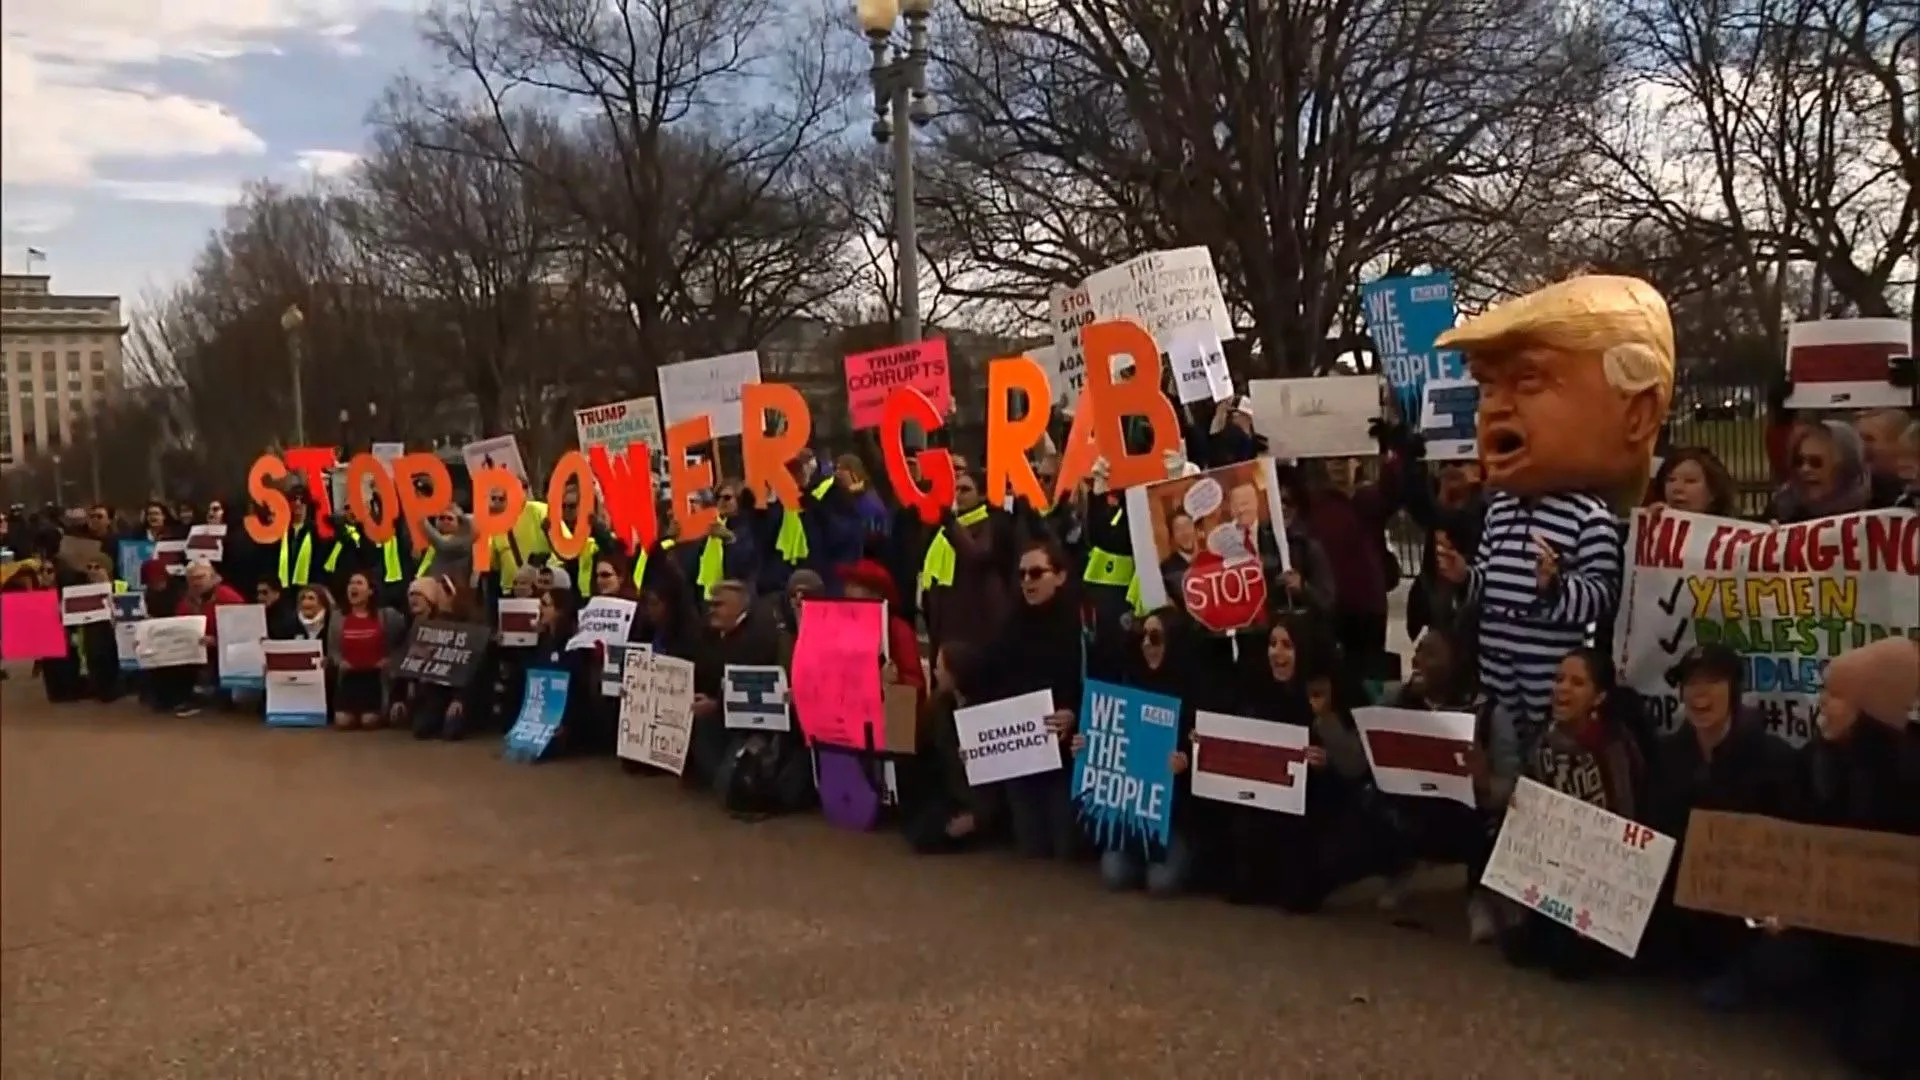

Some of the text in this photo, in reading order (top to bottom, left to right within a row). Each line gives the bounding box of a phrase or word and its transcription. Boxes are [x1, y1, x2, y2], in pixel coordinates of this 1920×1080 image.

[1369, 288, 1399, 323] WE
[1371, 322, 1408, 355] THE
[849, 360, 945, 392] CORRUPTS
[866, 350, 921, 369] TRUMP
[1381, 351, 1453, 388] PEOPLE
[579, 405, 626, 426] TRUMP
[244, 320, 1182, 572] STOP POWER GRAB
[1634, 514, 1690, 569] REAL
[1186, 567, 1261, 609] STOP
[1686, 575, 1857, 623] YEMEN
[1091, 692, 1128, 734] WE
[978, 721, 1036, 743] DEMAND
[1086, 730, 1130, 773] THE
[1080, 767, 1165, 821] PEOPLE
[1623, 823, 1656, 850] HP
